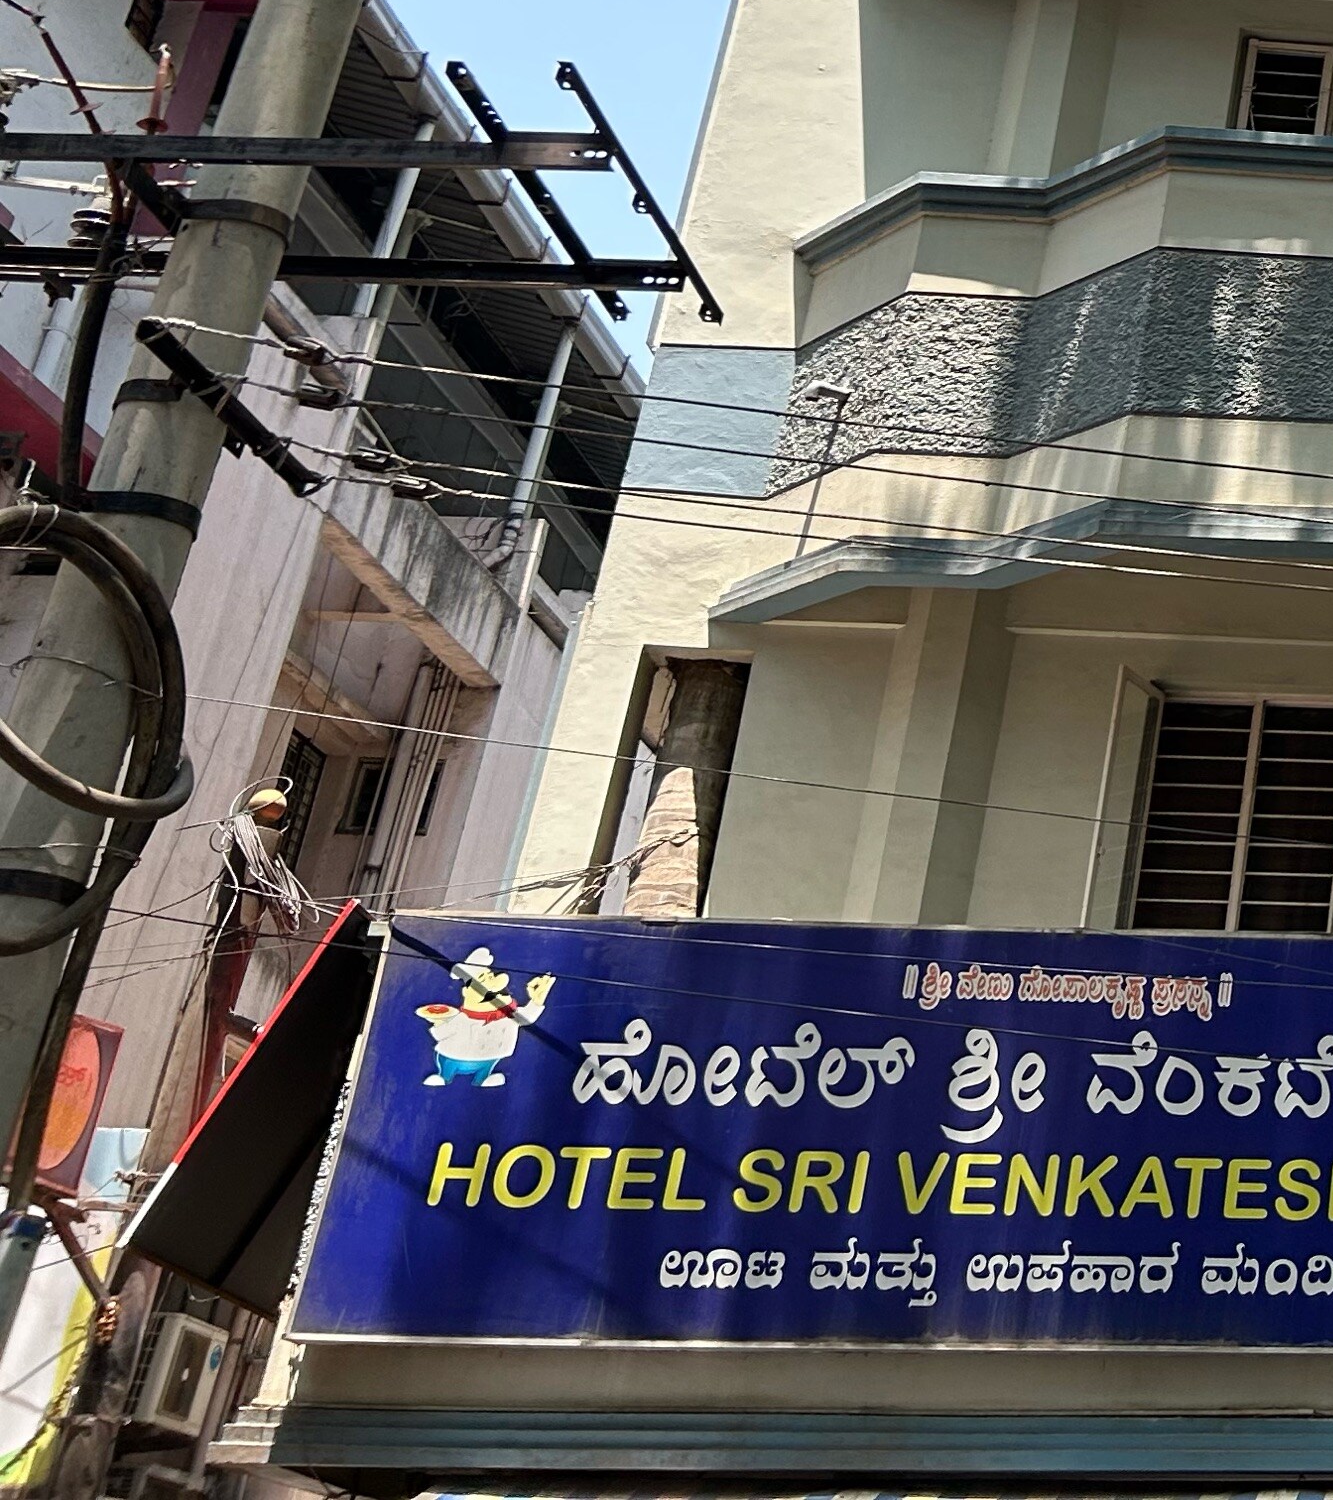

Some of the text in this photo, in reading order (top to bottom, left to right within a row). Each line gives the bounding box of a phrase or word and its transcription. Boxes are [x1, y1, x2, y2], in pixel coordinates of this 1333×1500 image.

[572, 1017, 916, 1109] ಹೋಟೆಲ್
[940, 1028, 1047, 1144] ಶ್ರೀ
[427, 1142, 706, 1210] HOTEL
[732, 1148, 871, 1215] SRI
[659, 1247, 786, 1291] ಊಟ
[809, 1236, 938, 1308] ಮತ್ತು
[966, 1239, 1182, 1295] ಉಪಹಾರ
